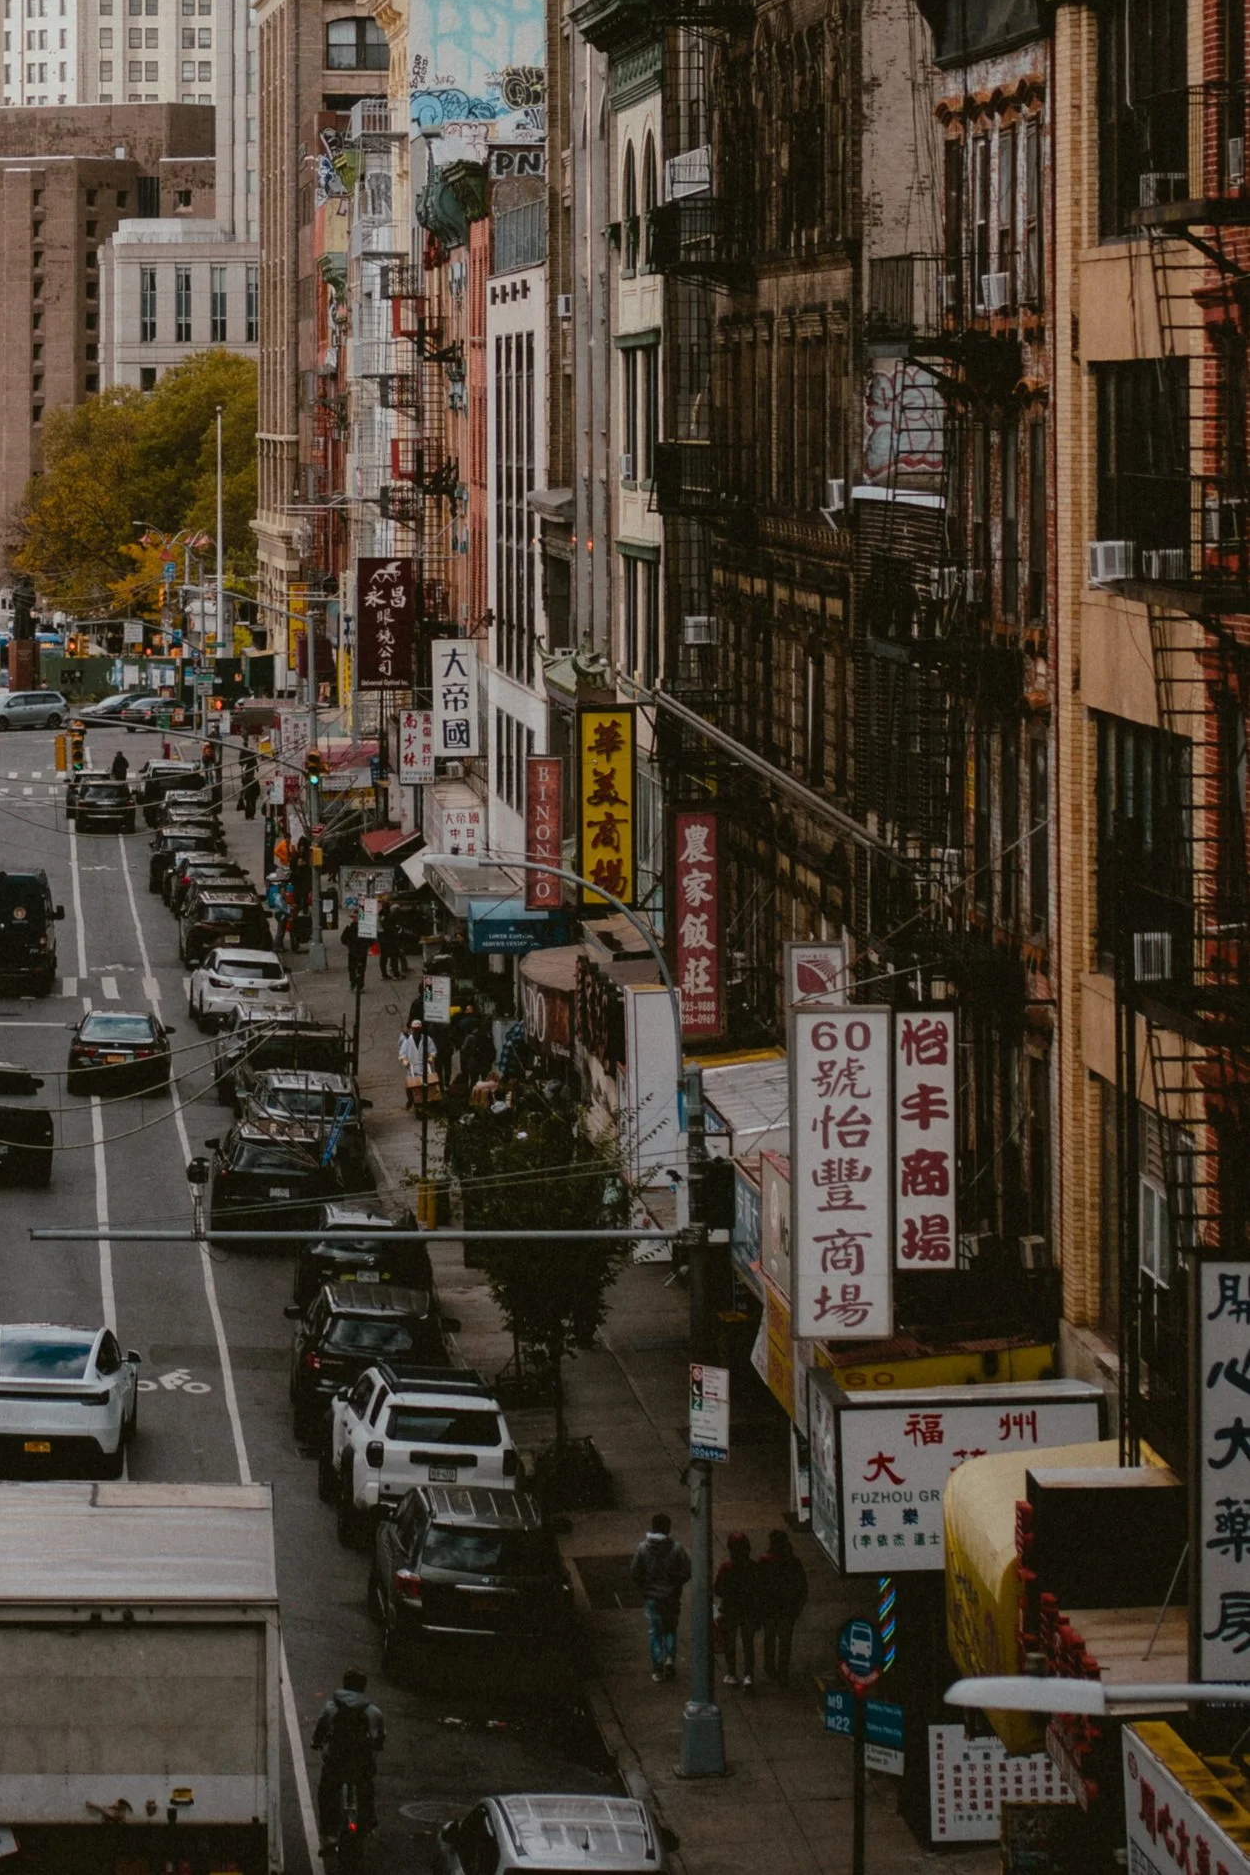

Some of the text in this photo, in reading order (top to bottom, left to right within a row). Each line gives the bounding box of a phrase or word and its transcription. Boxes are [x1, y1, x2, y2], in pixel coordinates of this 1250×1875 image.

[363, 585, 407, 609] 永昌
[374, 608, 396, 676] 眼鏡公司
[361, 677, 383, 687] Universal
[441, 647, 470, 749] 大帝國
[402, 713, 418, 768] 南少林
[586, 719, 629, 901] 華美商場
[679, 824, 717, 997] 農家飯莊
[844, 1373, 895, 1387] 60
[851, 1490, 914, 1504] FUZHOU
[826, 1694, 844, 1710] M9
[826, 1715, 851, 1732] M22
